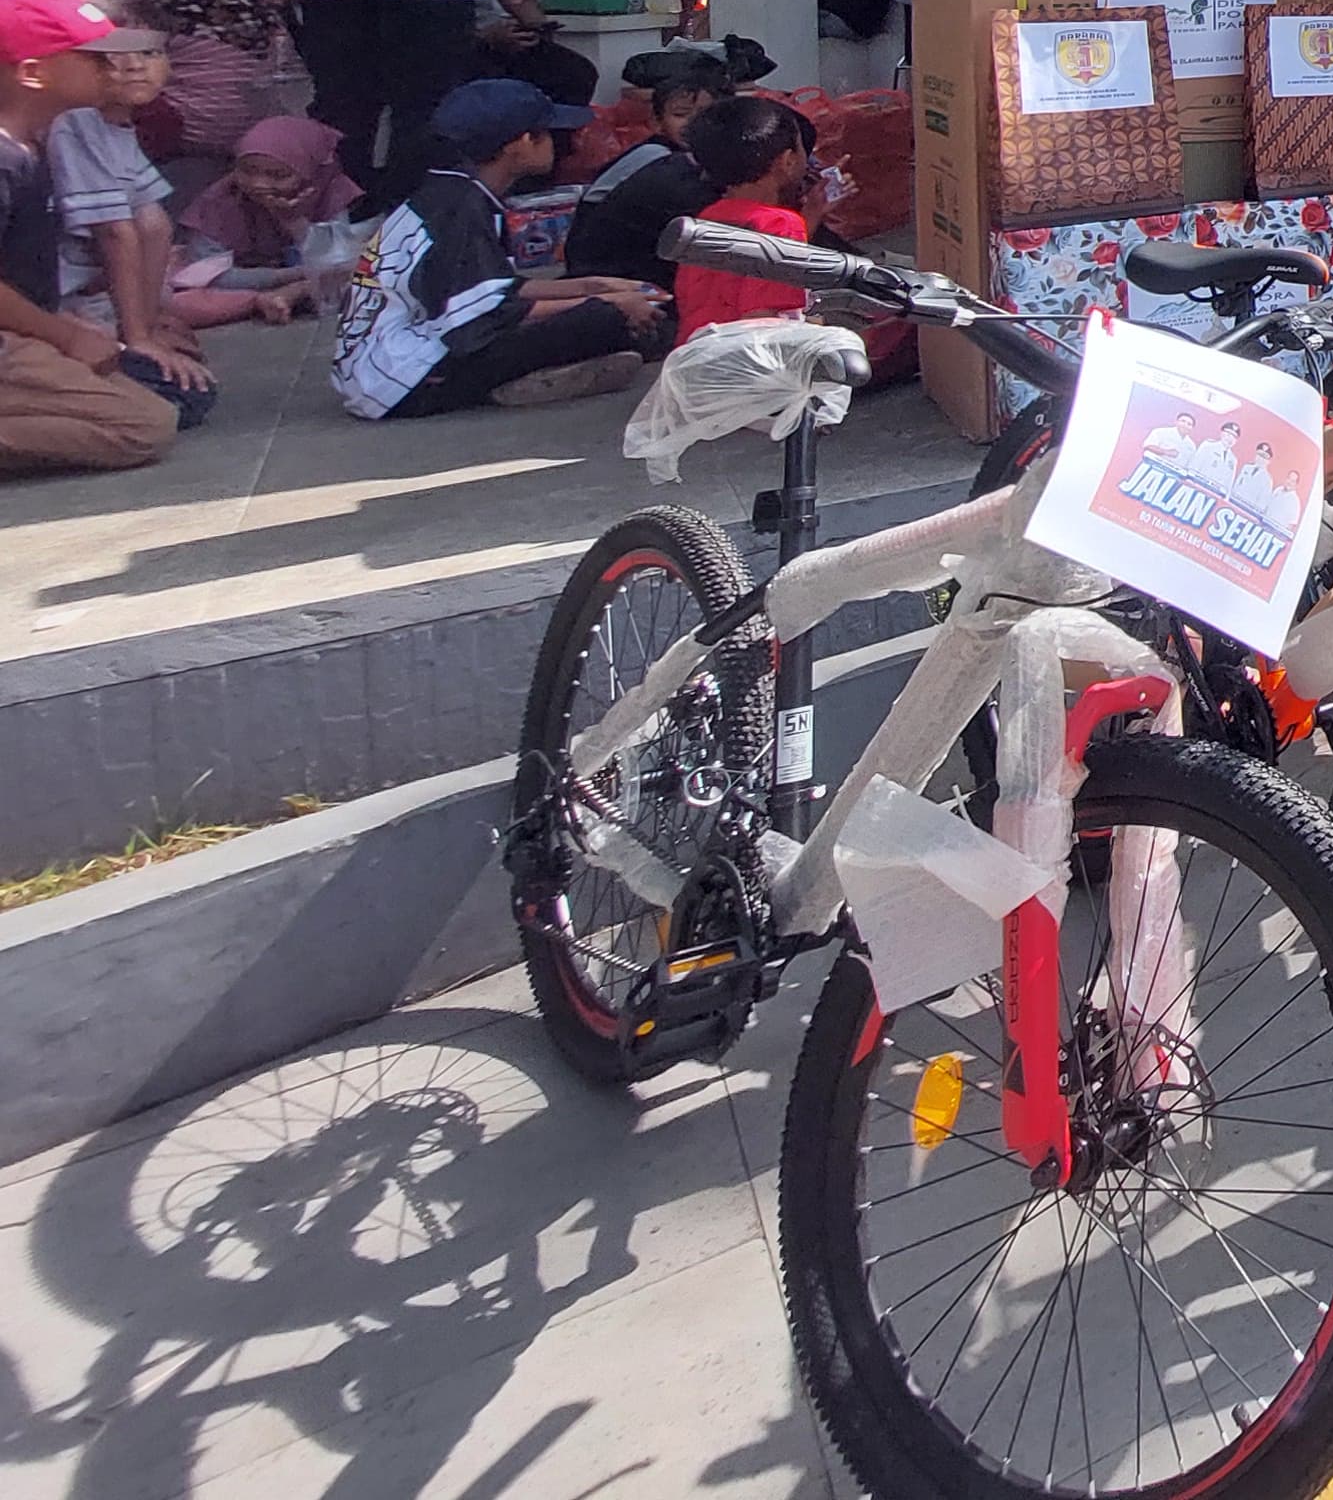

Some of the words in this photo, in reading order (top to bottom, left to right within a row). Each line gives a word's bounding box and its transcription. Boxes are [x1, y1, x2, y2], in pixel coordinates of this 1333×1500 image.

[1217, 0, 1244, 8] DIS
[1119, 460, 1216, 529] JALAN
[1208, 507, 1286, 570] SEHAT
[785, 712, 811, 734] SN
